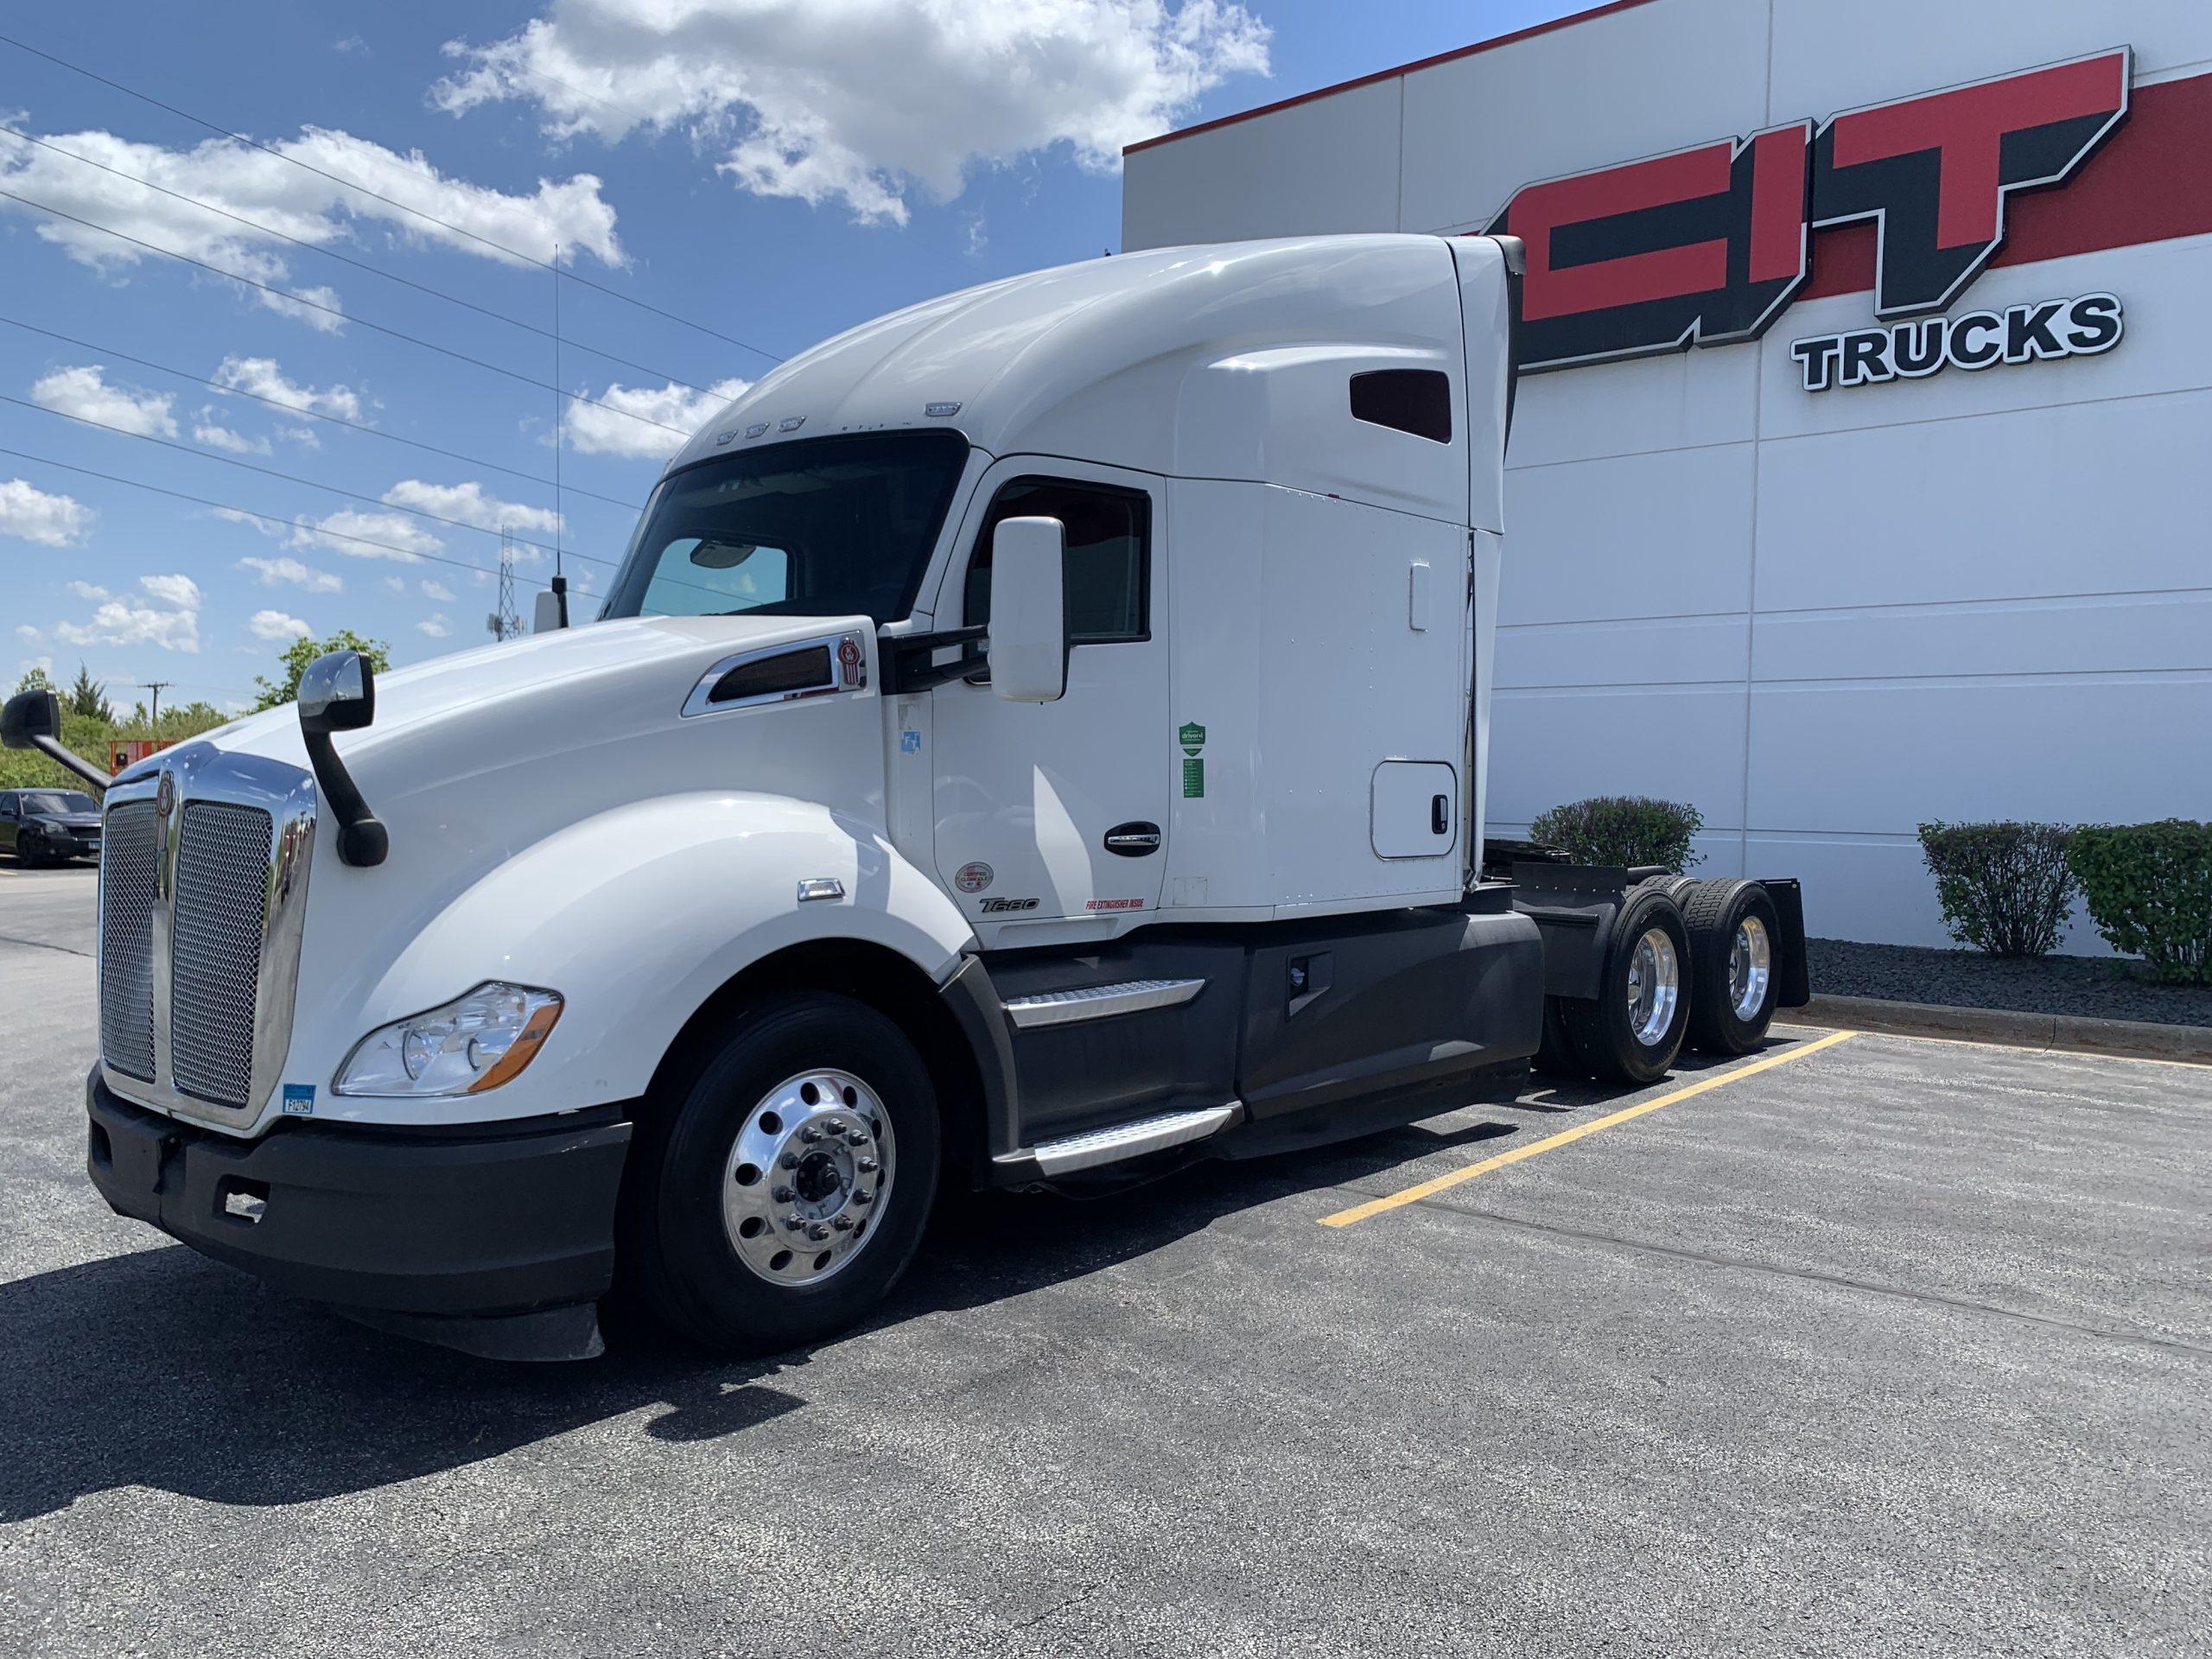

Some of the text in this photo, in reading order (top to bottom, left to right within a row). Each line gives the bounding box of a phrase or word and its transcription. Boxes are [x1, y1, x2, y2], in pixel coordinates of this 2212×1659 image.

[1488, 44, 2133, 354] CIT
[1791, 294, 2124, 388] TRUCKS
[979, 897, 1040, 913] T680
[1085, 898, 1144, 910] FIRE EXTINGUISHER INSIDE
